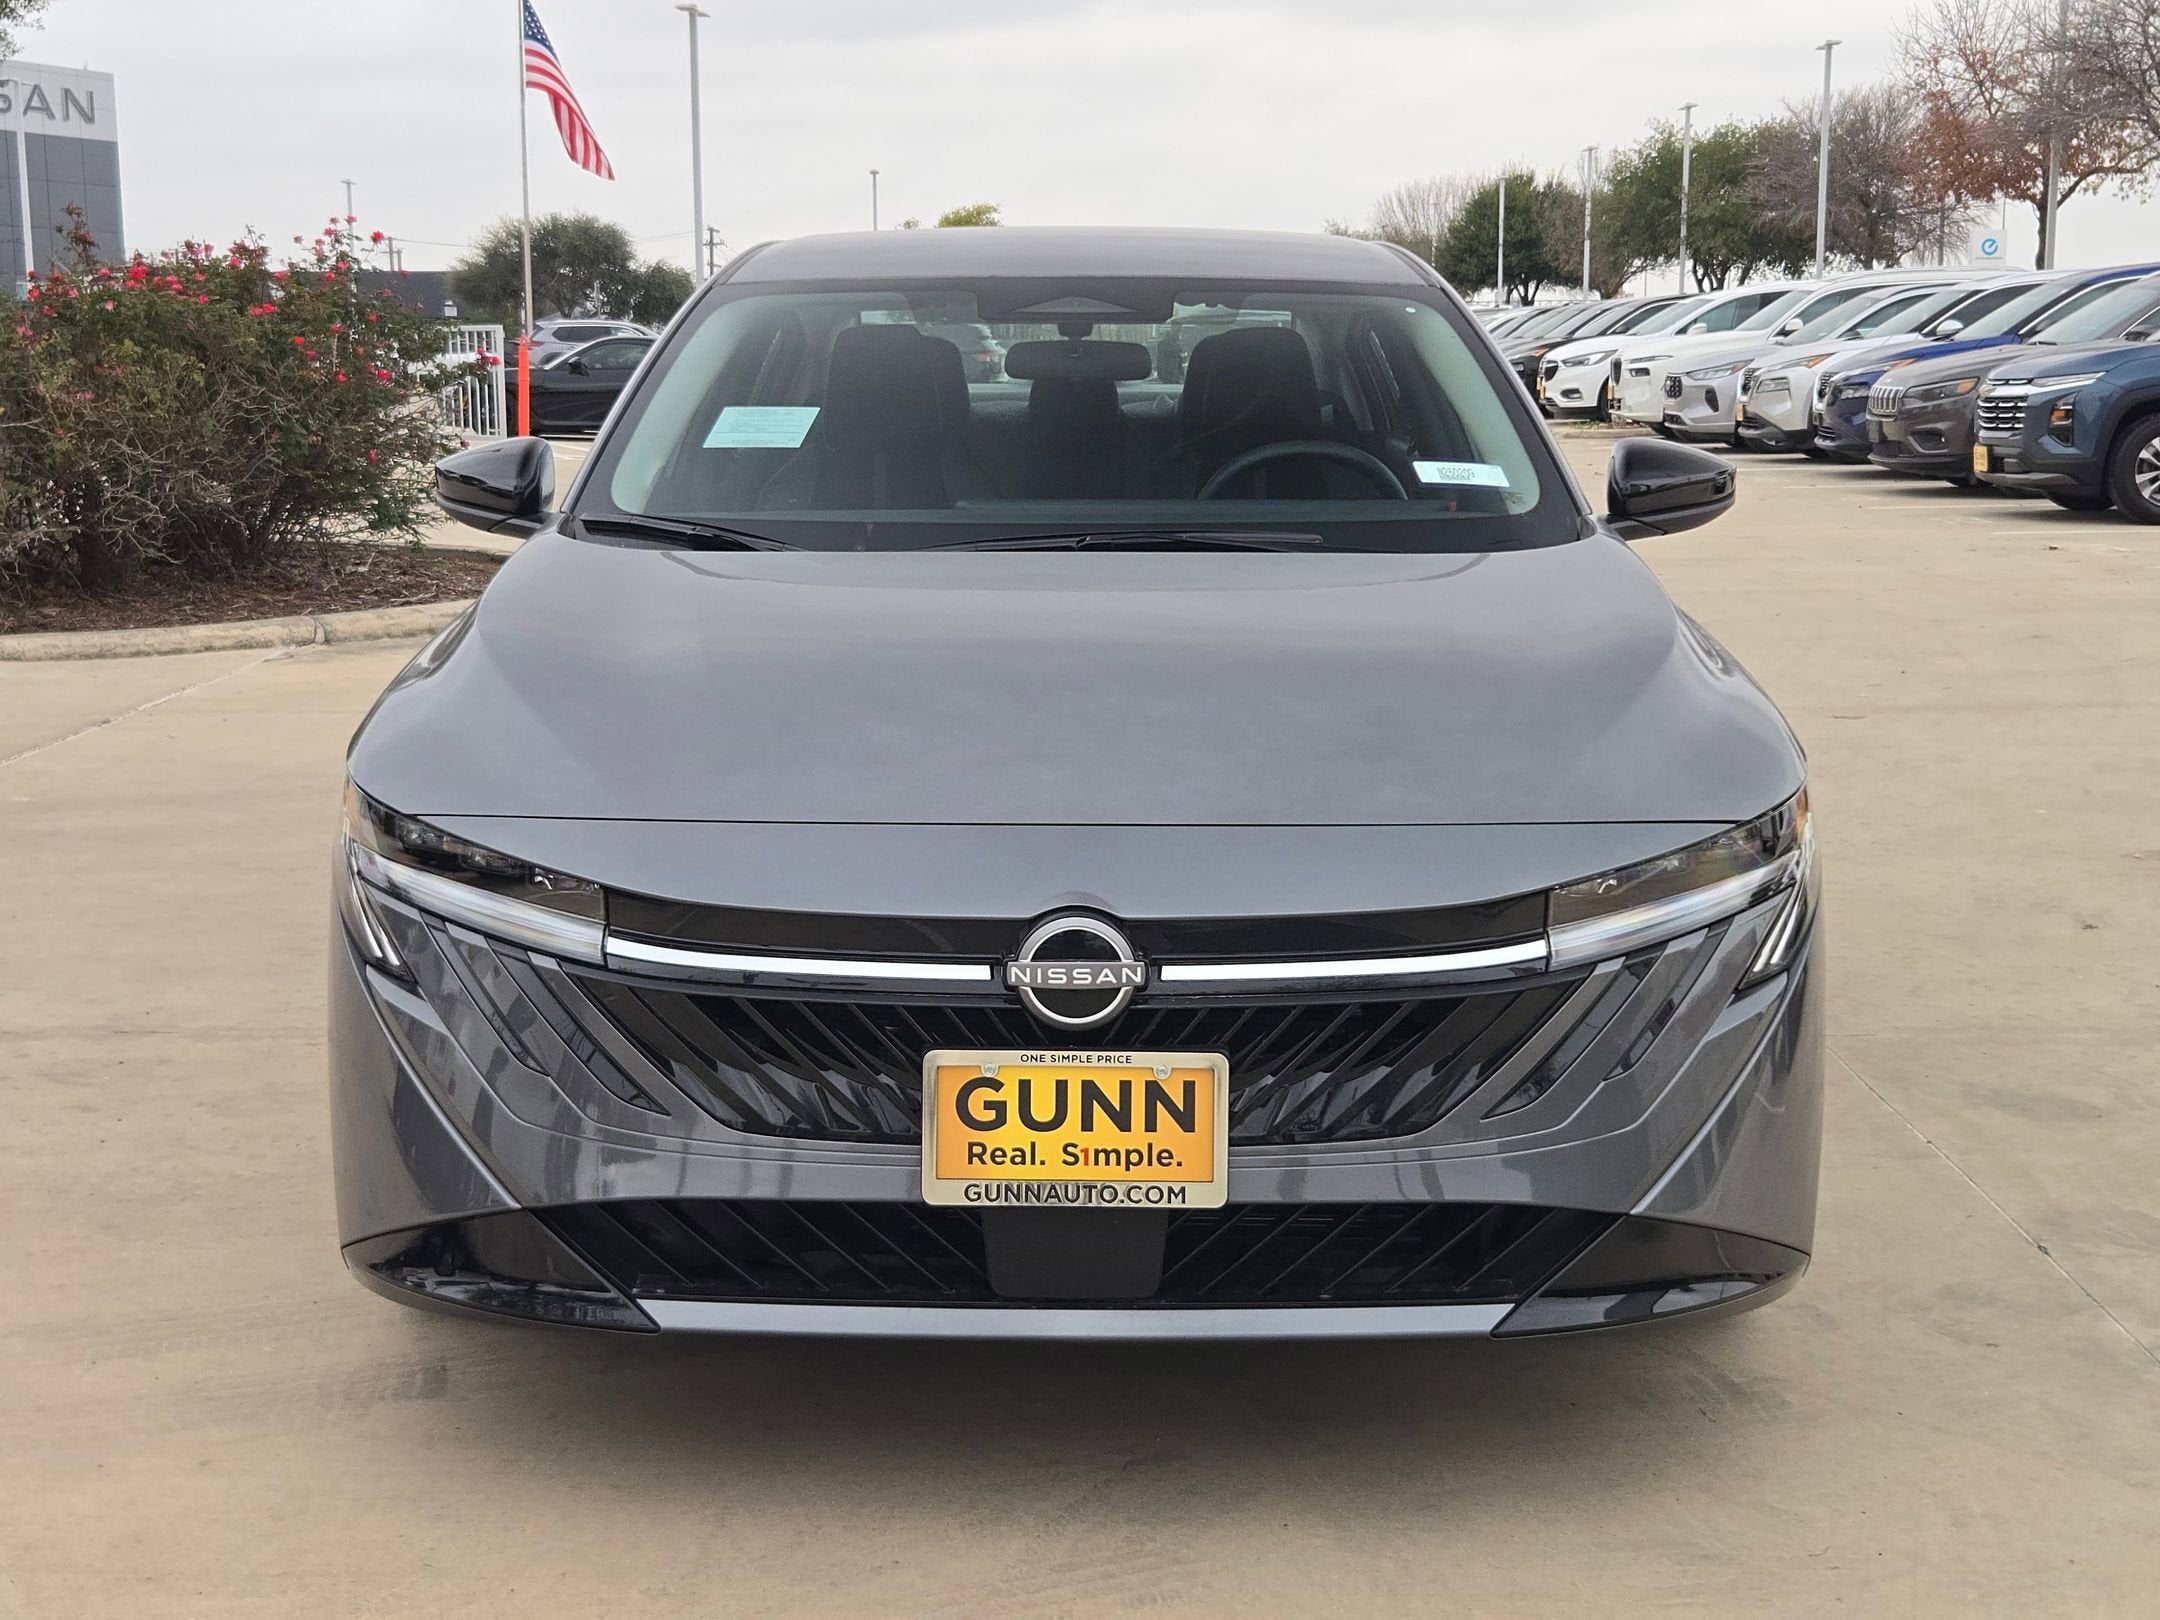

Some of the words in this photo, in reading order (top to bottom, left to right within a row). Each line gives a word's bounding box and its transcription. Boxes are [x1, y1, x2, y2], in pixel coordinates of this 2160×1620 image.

[1010, 966, 1142, 984] NISSAN
[1020, 1053, 1047, 1063] ONE
[1050, 1054, 1093, 1064] SIMPLE
[1097, 1055, 1133, 1064] PRICE
[955, 1077, 1196, 1133] GUNN
[967, 1141, 1046, 1166] Real.
[963, 1183, 1187, 1205] GUNNAUTO.COM
